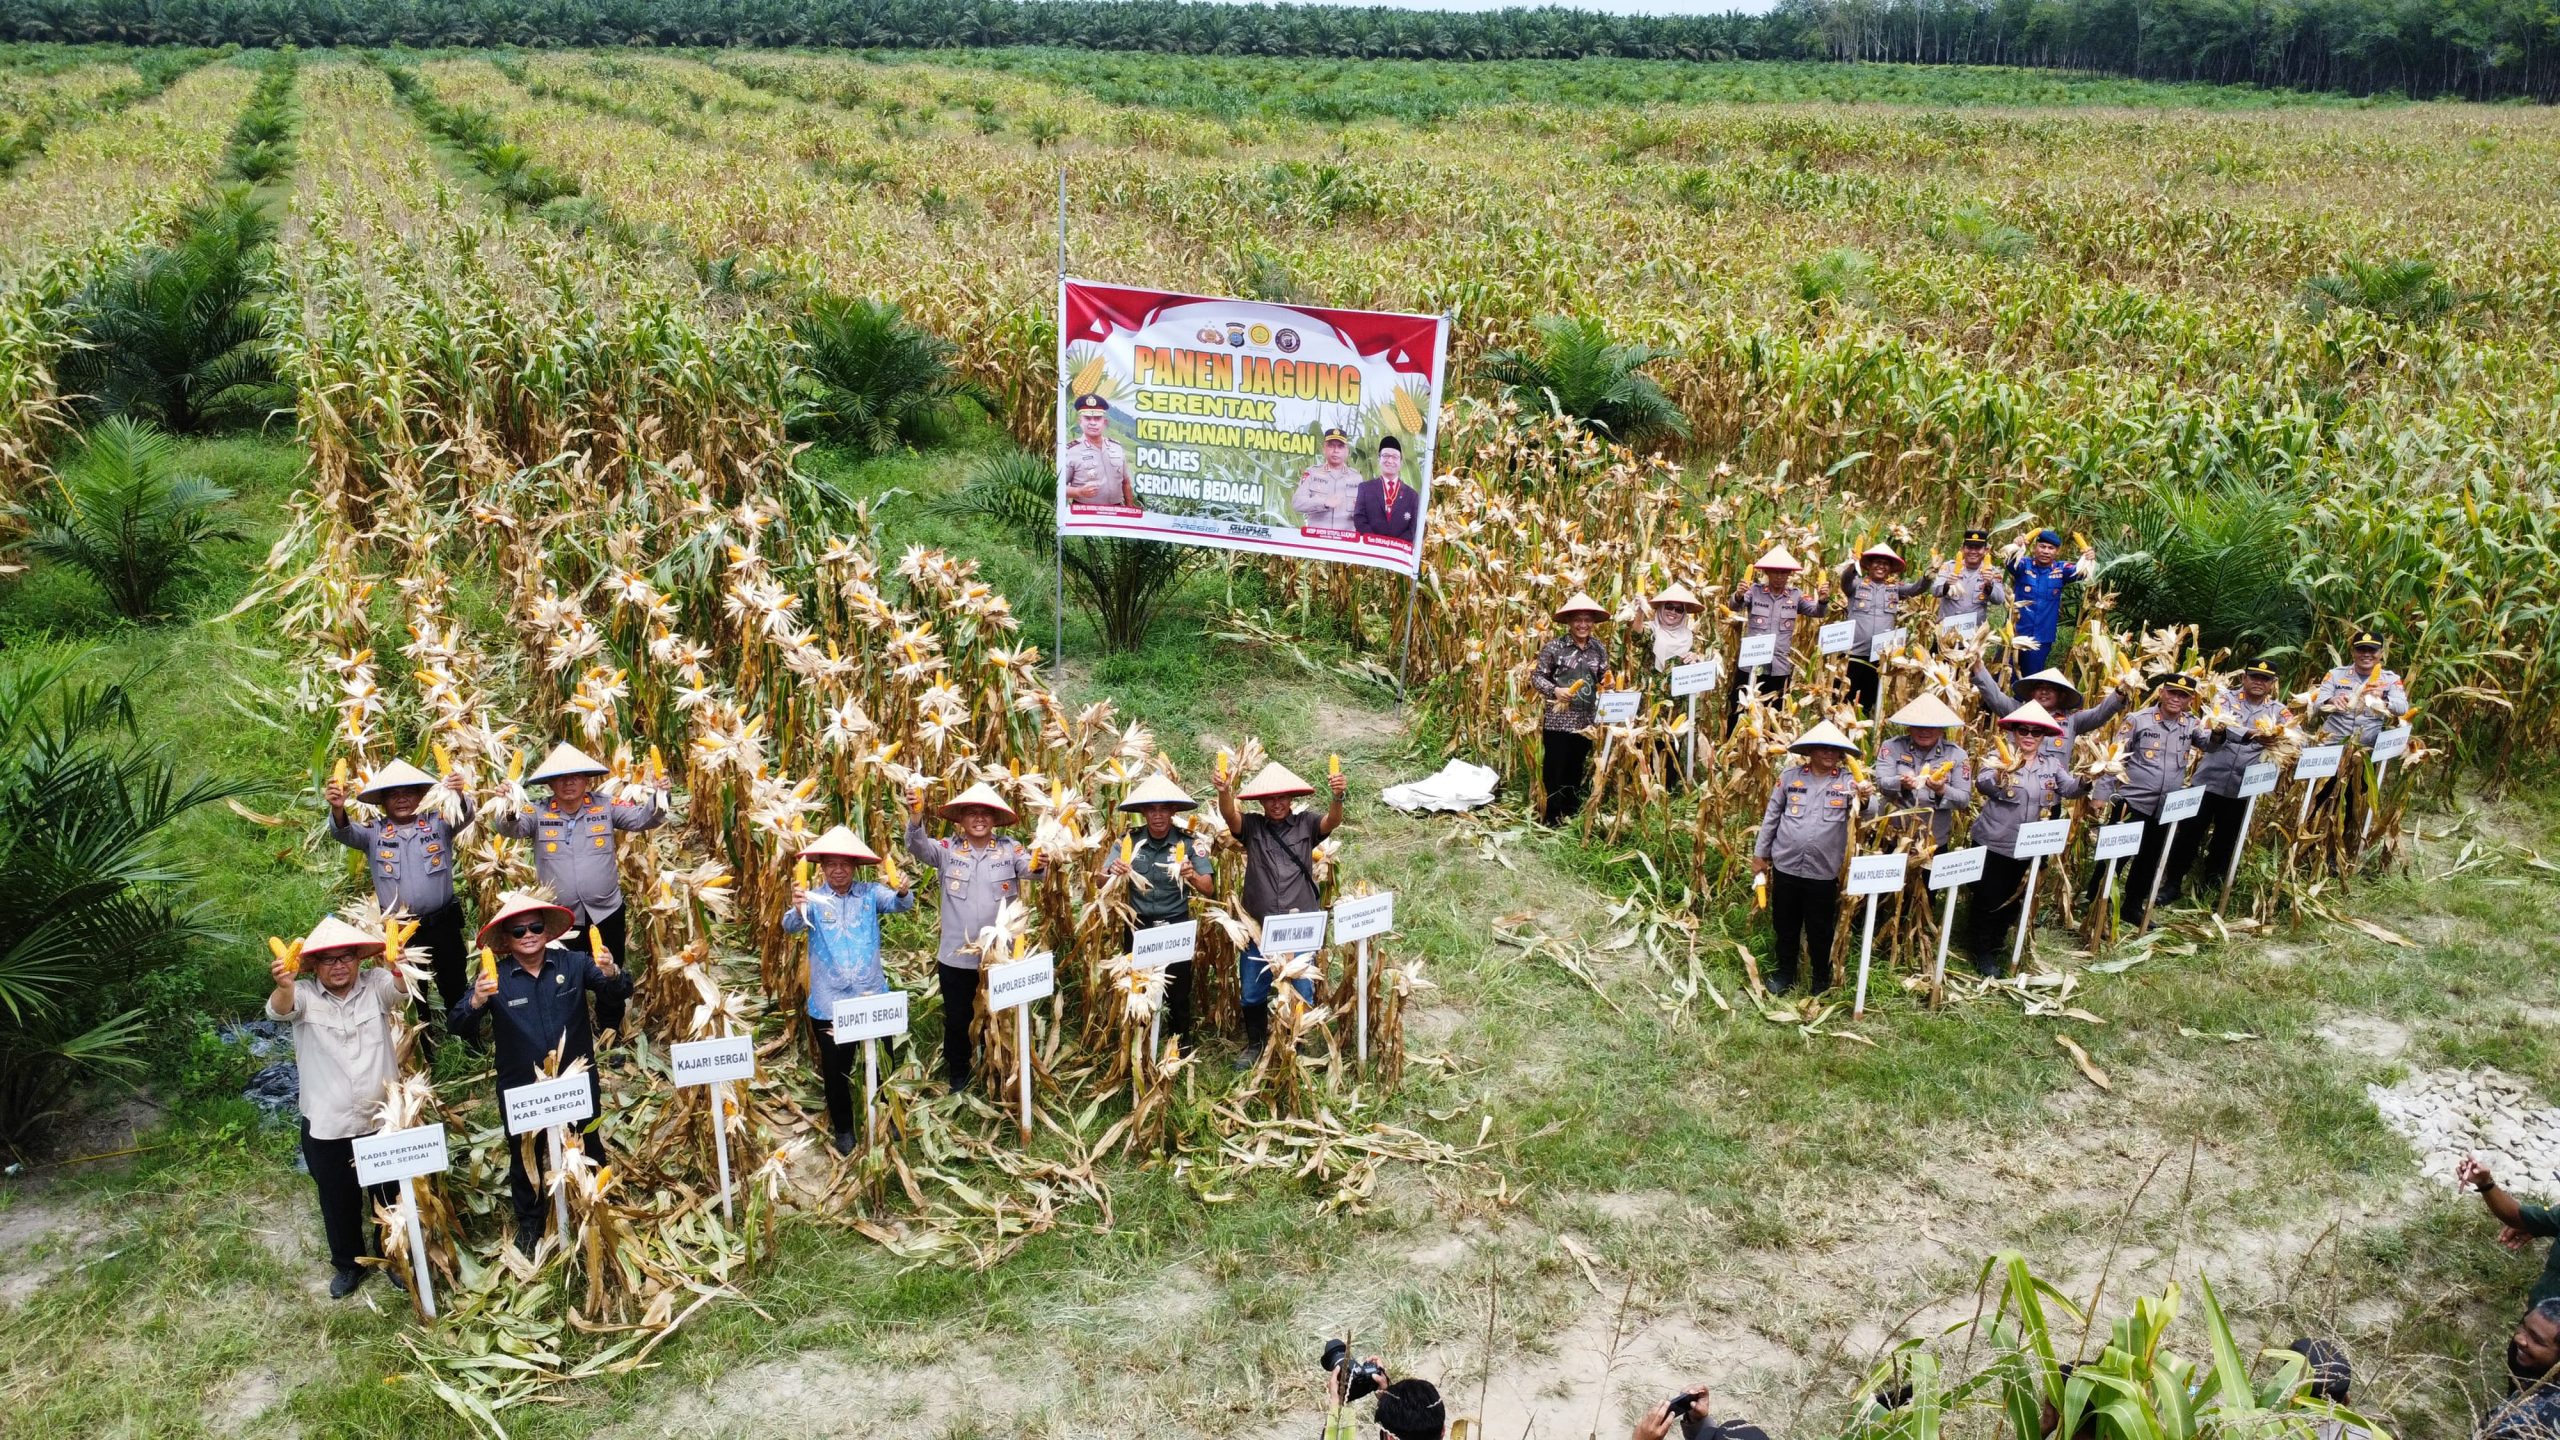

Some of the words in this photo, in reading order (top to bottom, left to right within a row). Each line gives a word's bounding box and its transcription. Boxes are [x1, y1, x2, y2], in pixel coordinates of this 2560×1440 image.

[1134, 345, 1234, 392] PANEN
[1239, 355, 1362, 407] JAGUNG
[1135, 391, 1277, 423] SERENTAK
[1136, 418, 1241, 450] KETAHANAN
[1243, 427, 1316, 456] PANGAN
[1136, 446, 1200, 473] POLRES
[1135, 473, 1200, 500] SERDANG
[1202, 480, 1264, 506] BEDAGAI
[1171, 522, 1220, 534] PRESISI
[1229, 524, 1270, 535] GUGUS
[2142, 731, 2161, 740] ANDI
[587, 815, 608, 823] POLRI
[420, 832, 440, 845] POLRI
[950, 858, 970, 869] SITEPU
[991, 860, 1011, 869] POLRI
[1935, 870, 1958, 878] POLRES
[1959, 865, 1981, 873] SERGAI
[1867, 869, 1885, 880] POLRES
[1885, 868, 1901, 878] SERGAI
[1351, 908, 1376, 920] PENGADILAN
[1137, 942, 1164, 955] DANDIM
[1164, 938, 1181, 950] 0204
[1181, 936, 1191, 947] DS
[993, 976, 1026, 995] KAPOLRES
[1027, 970, 1050, 986] SERGAI
[838, 1011, 868, 1028] BUPATI
[872, 1007, 903, 1022] SERGAI
[677, 1057, 712, 1071] KAJARI
[714, 1052, 748, 1066] SERGAI
[512, 1096, 551, 1110] KETUA
[554, 1088, 584, 1101] DPRD
[513, 1110, 541, 1121] KAB.
[544, 1099, 586, 1114] SERGAI
[360, 1150, 388, 1161] KADIS
[390, 1141, 439, 1155] PERTANIAN
[373, 1160, 396, 1168] KAB.
[397, 1152, 429, 1163] SERGAI
